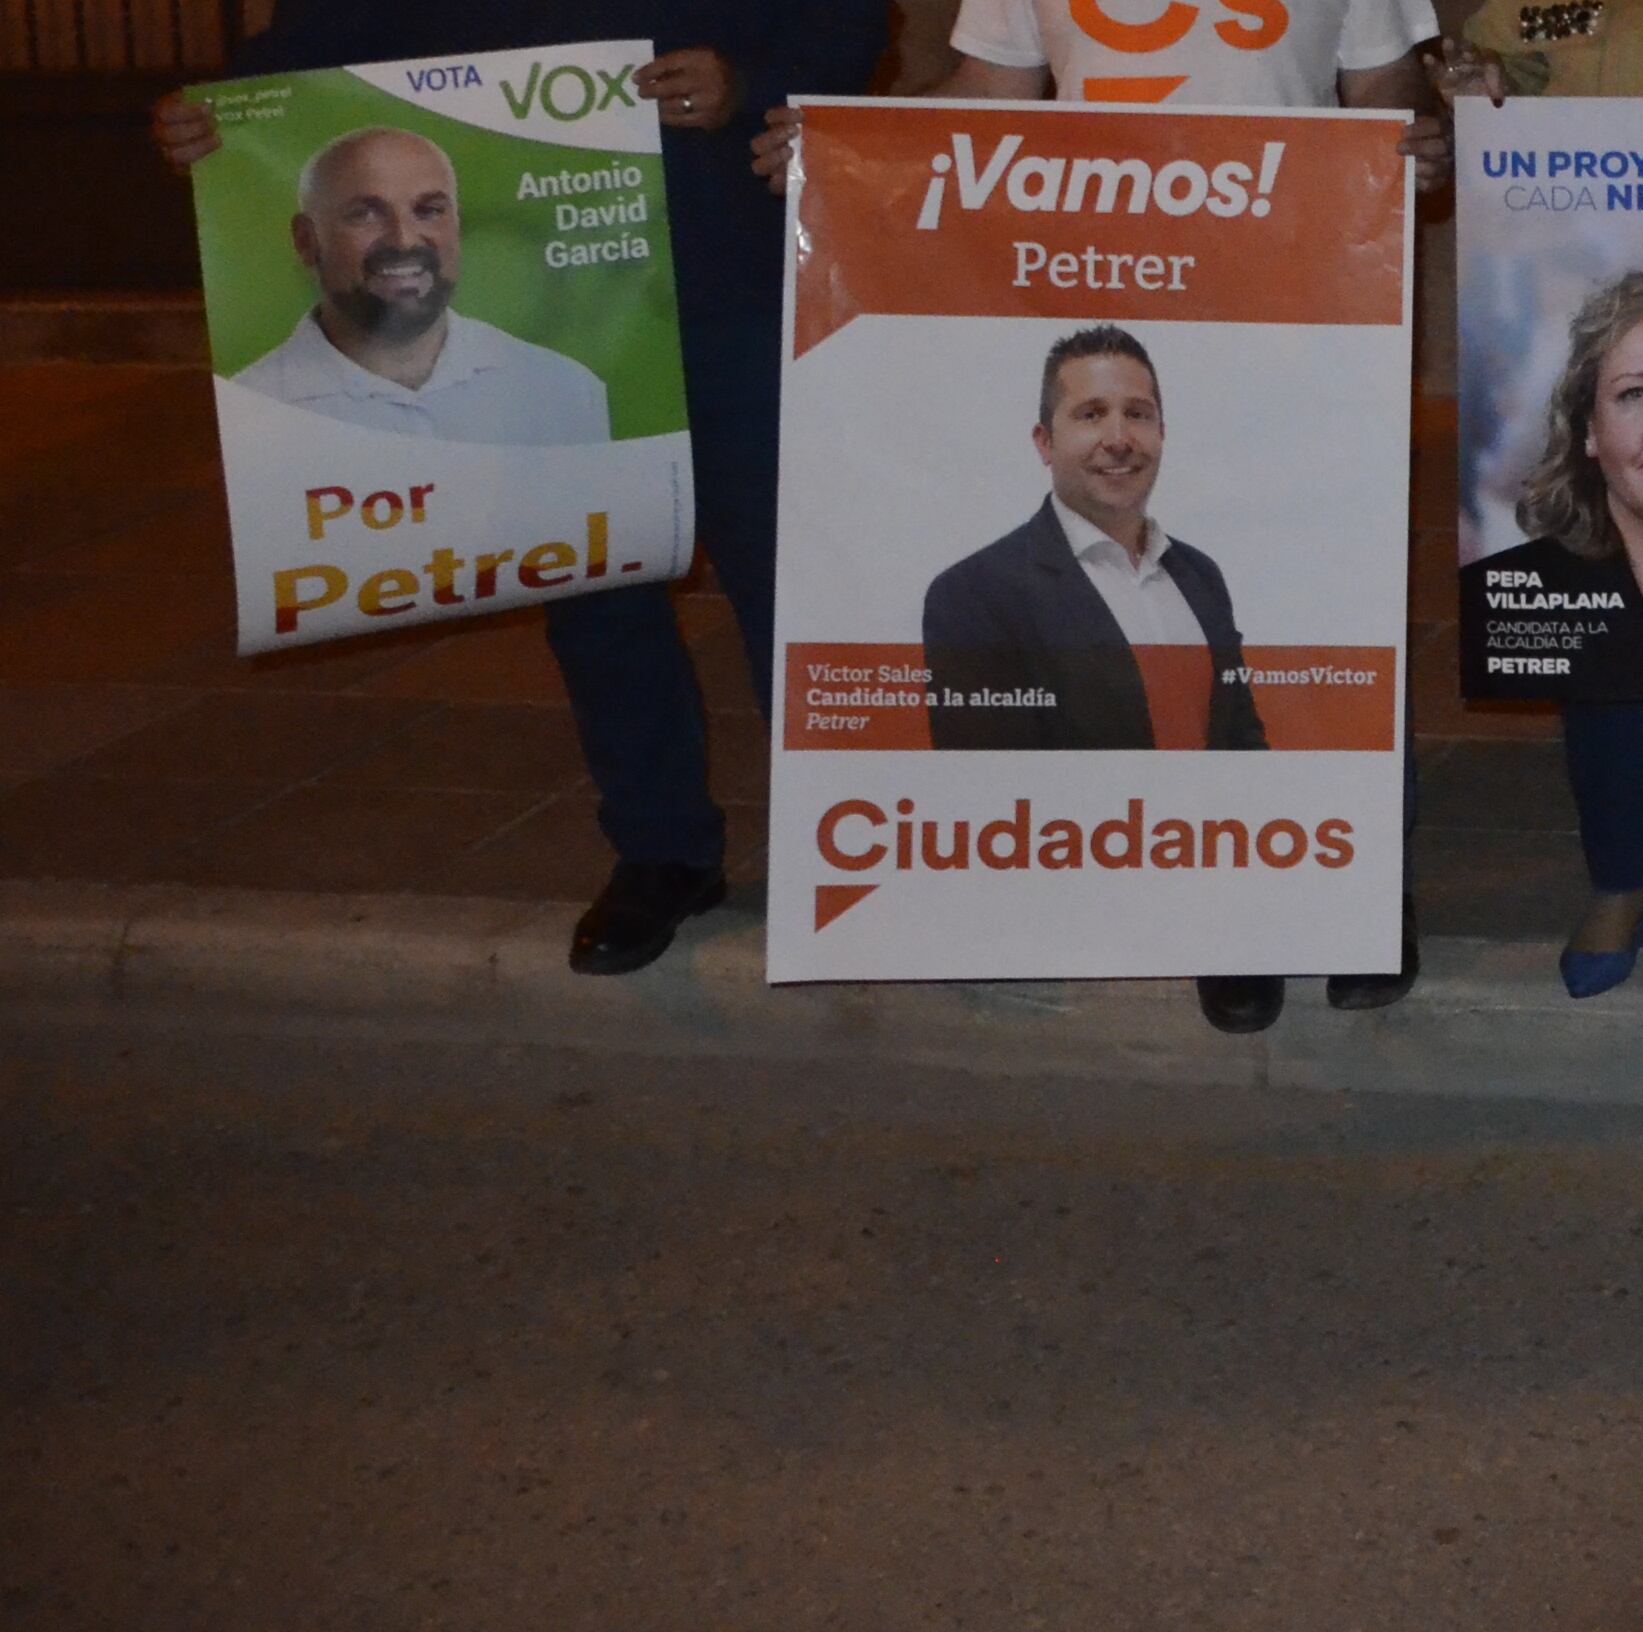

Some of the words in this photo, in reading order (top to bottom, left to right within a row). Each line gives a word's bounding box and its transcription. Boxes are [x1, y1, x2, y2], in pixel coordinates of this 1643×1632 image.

[406, 64, 483, 94] VOTA
[499, 61, 636, 121] VOX
[1482, 150, 1537, 179] UN
[516, 161, 643, 201] Antonio
[916, 132, 1286, 231] ¡Vamos!
[1503, 185, 1598, 212] CADA
[555, 195, 648, 232] David
[544, 231, 650, 269] García
[1012, 242, 1196, 292] Petrer
[305, 482, 435, 540] Por
[273, 511, 643, 635] Petrel.
[1486, 570, 1543, 589] PEPA
[1486, 591, 1625, 610] VILLAPLANA
[1486, 620, 1570, 636] CANDIDATA
[1572, 621, 1587, 635] A
[1588, 621, 1609, 635] LA
[1486, 632, 1560, 650] ALCALDÍA
[1562, 636, 1583, 650] DE
[806, 663, 873, 684] Víctor
[878, 664, 933, 684] Sales
[1221, 665, 1378, 687] #VamosVíctor
[1486, 656, 1571, 675] PETRER
[806, 687, 921, 708] Candidato
[925, 691, 939, 708] a
[943, 687, 965, 708] la
[969, 686, 1058, 708] alcaldía
[804, 712, 871, 731] Petrer
[816, 798, 1356, 871] Ciudadanos
